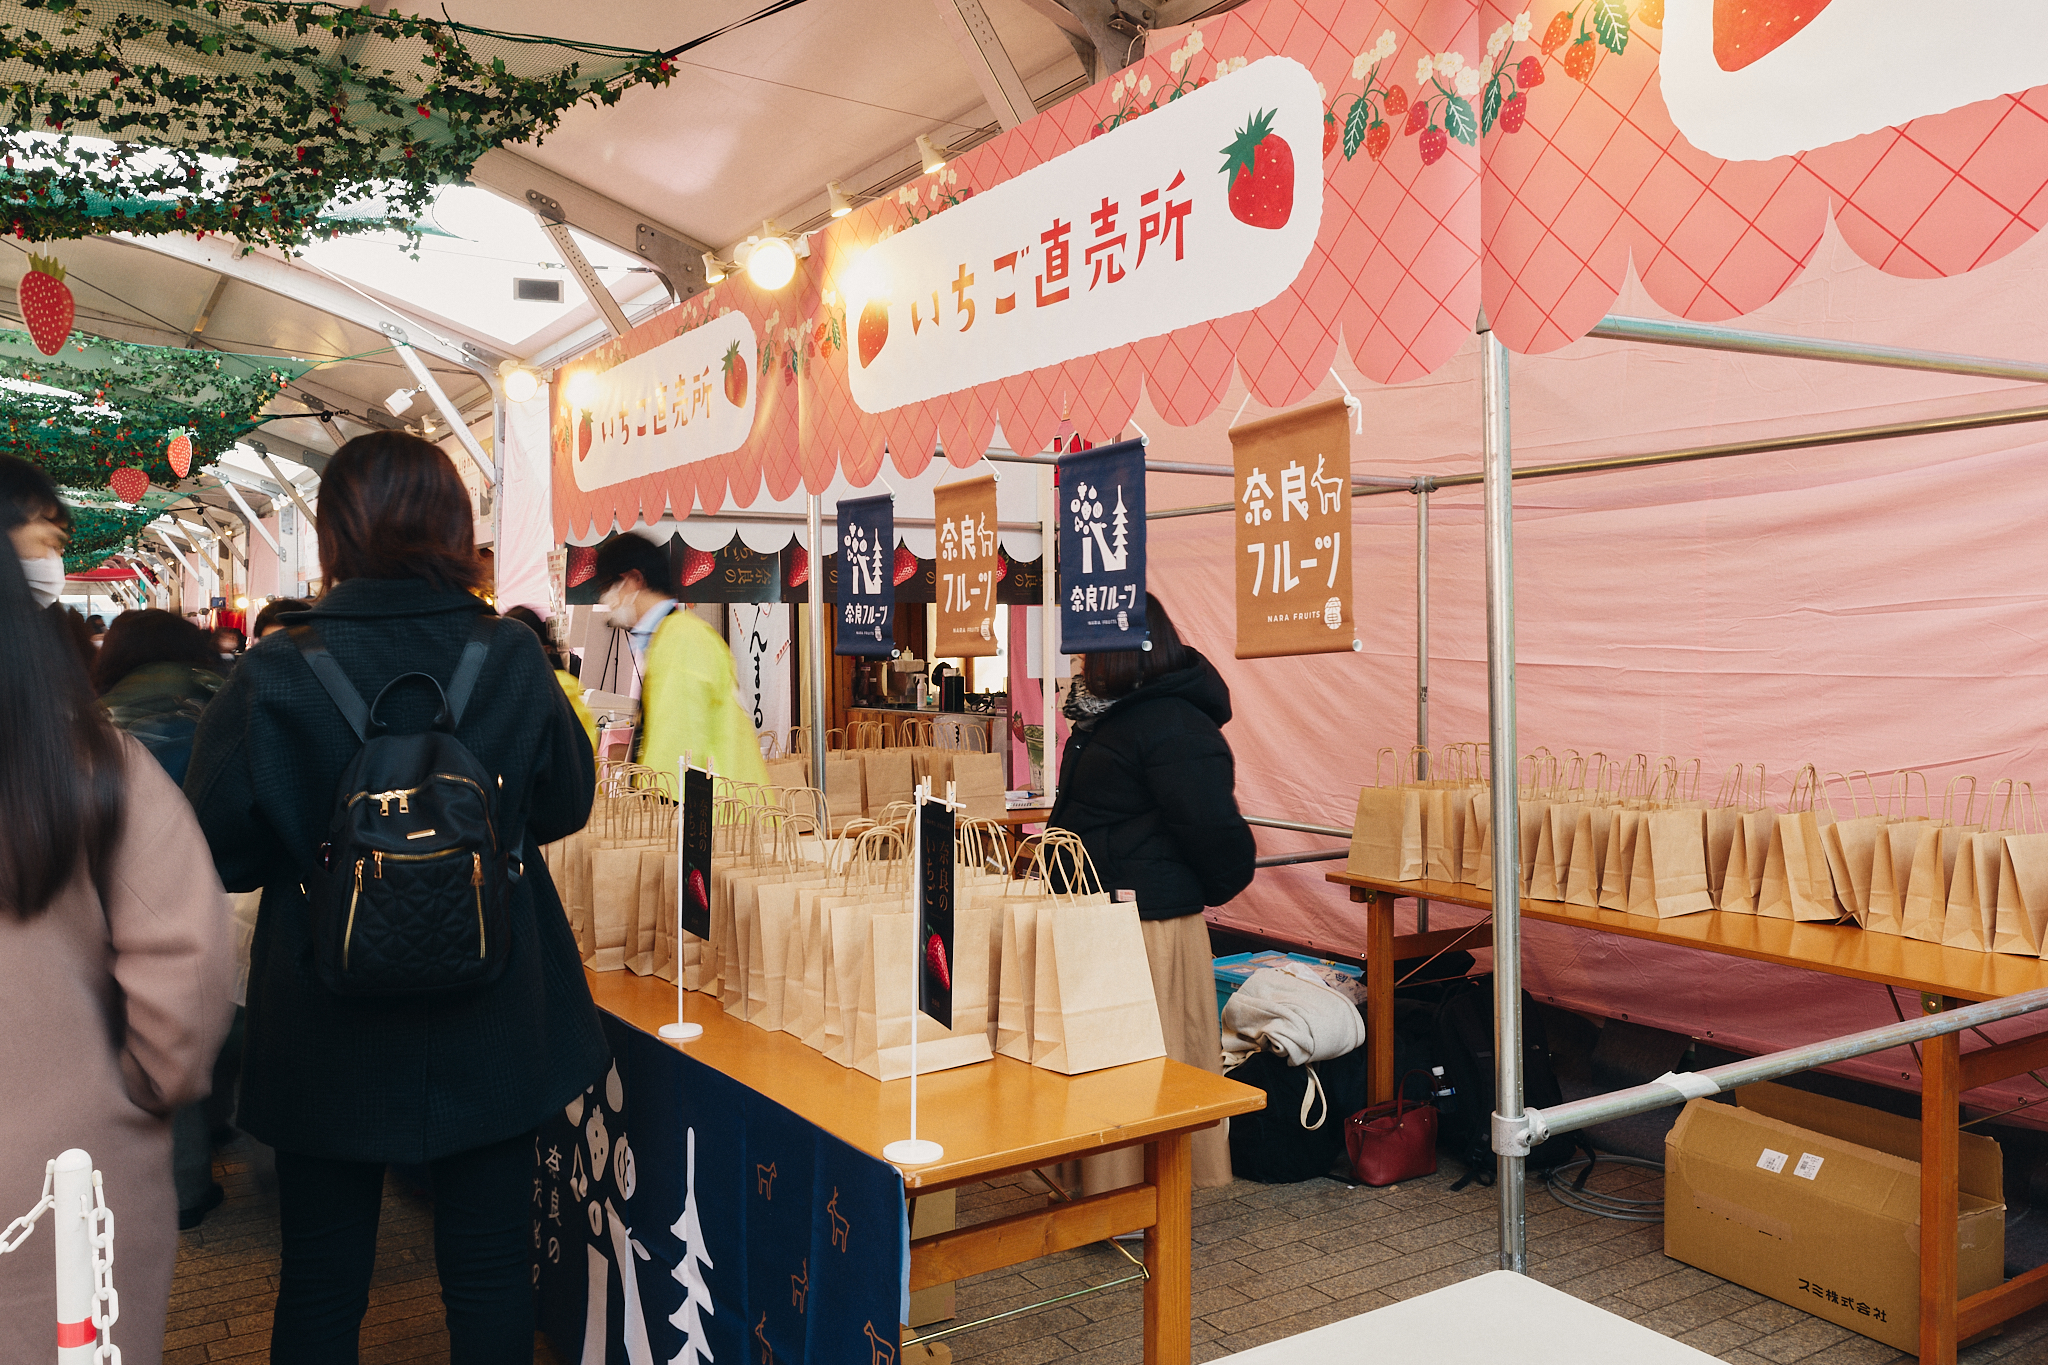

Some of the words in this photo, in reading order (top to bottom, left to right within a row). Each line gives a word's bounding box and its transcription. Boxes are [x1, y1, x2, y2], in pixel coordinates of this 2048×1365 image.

[910, 168, 1193, 335] いちご直売所
[600, 364, 713, 446] いちご直売所
[1242, 460, 1309, 526] 奈良
[940, 514, 977, 562] 奈良
[1247, 532, 1341, 597] フルーツ
[845, 602, 888, 625] 奈良フルーツ
[942, 570, 992, 614] フルーツ
[1070, 584, 1137, 613] 奈良フルーツ
[1267, 614, 1290, 623] NARA
[1293, 611, 1321, 621] FRUITS
[925, 835, 936, 906] いちご
[939, 840, 950, 912] 奈良の
[1797, 1278, 1888, 1324] スミ株式会社
